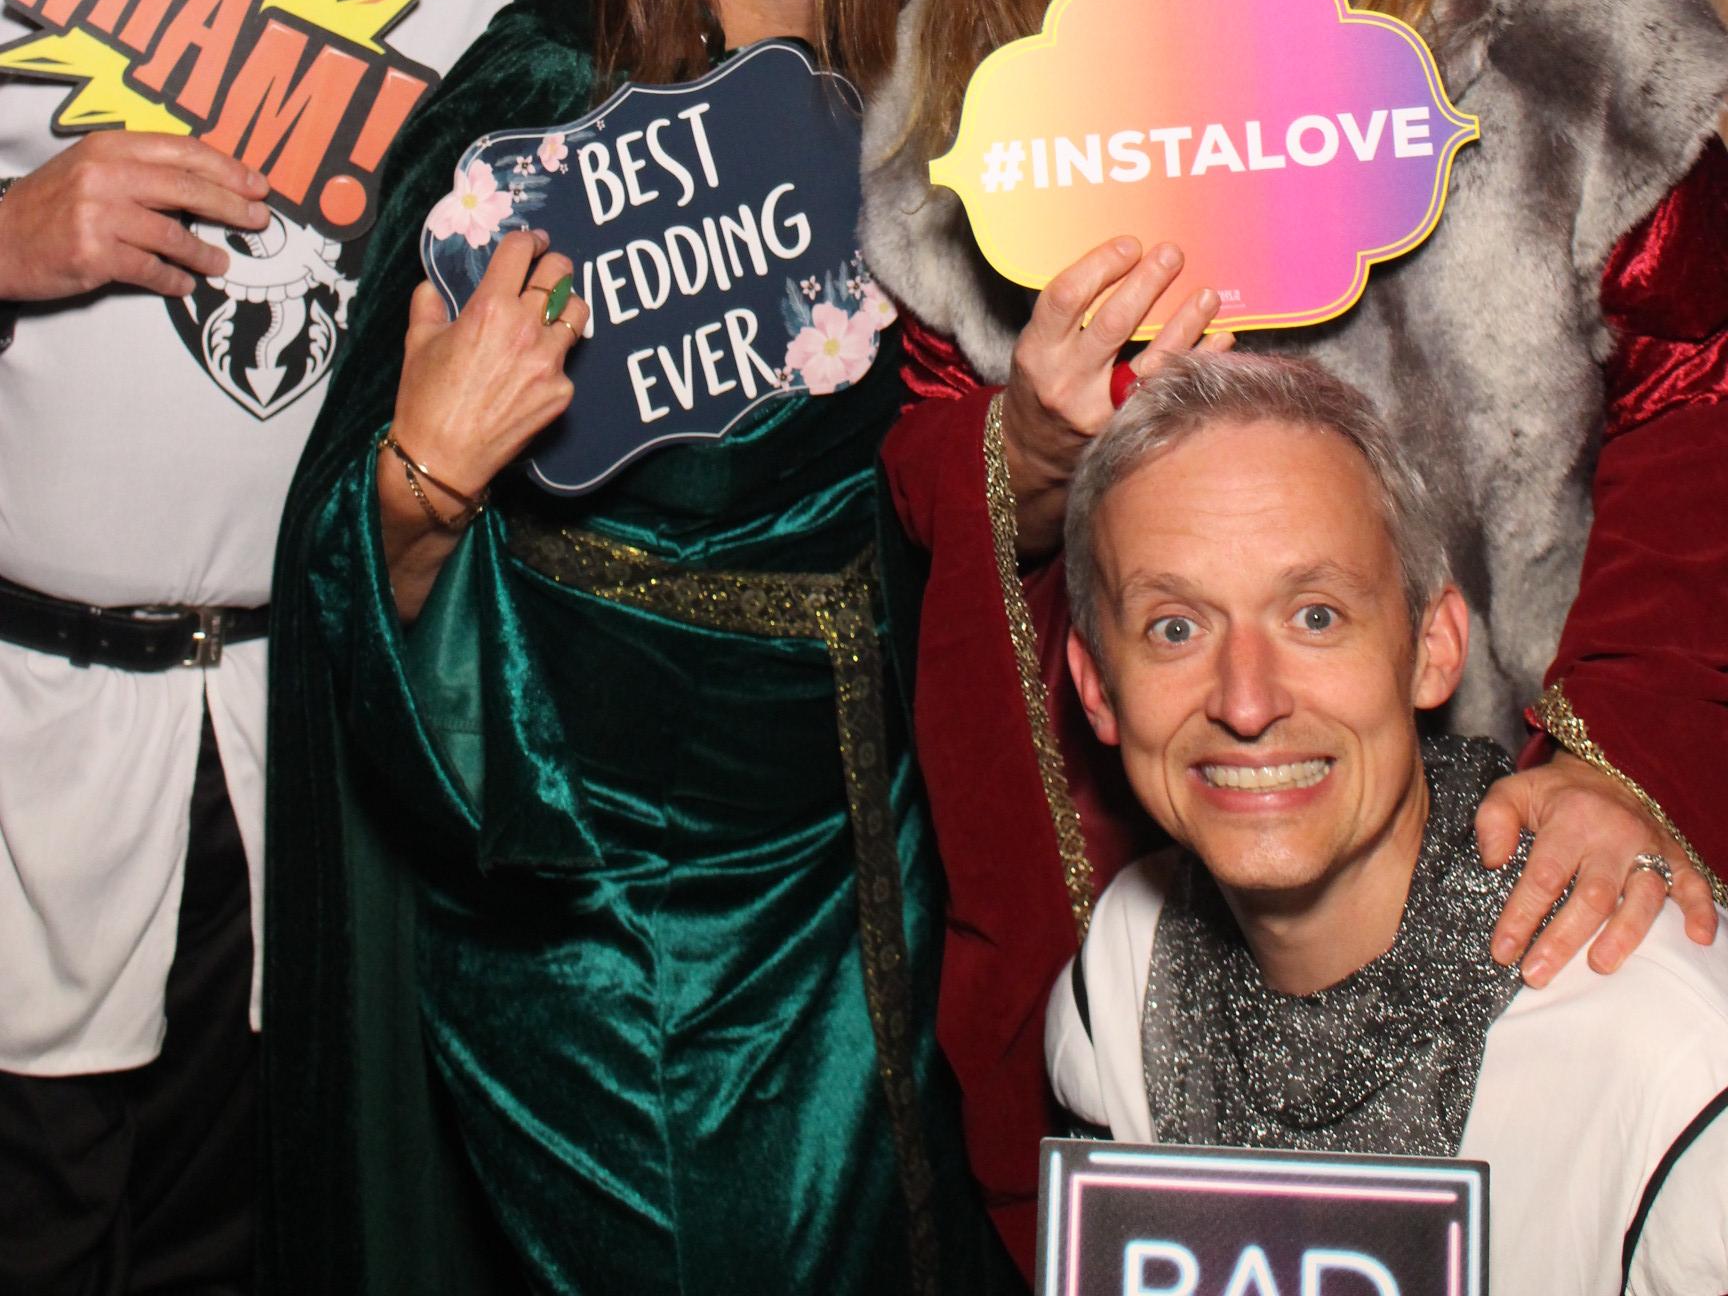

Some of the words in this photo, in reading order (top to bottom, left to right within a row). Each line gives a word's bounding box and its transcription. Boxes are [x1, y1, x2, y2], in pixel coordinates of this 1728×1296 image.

[579, 102, 719, 225] BEST
[980, 106, 1434, 193] #INSTALOVE
[627, 308, 778, 423] EVER
